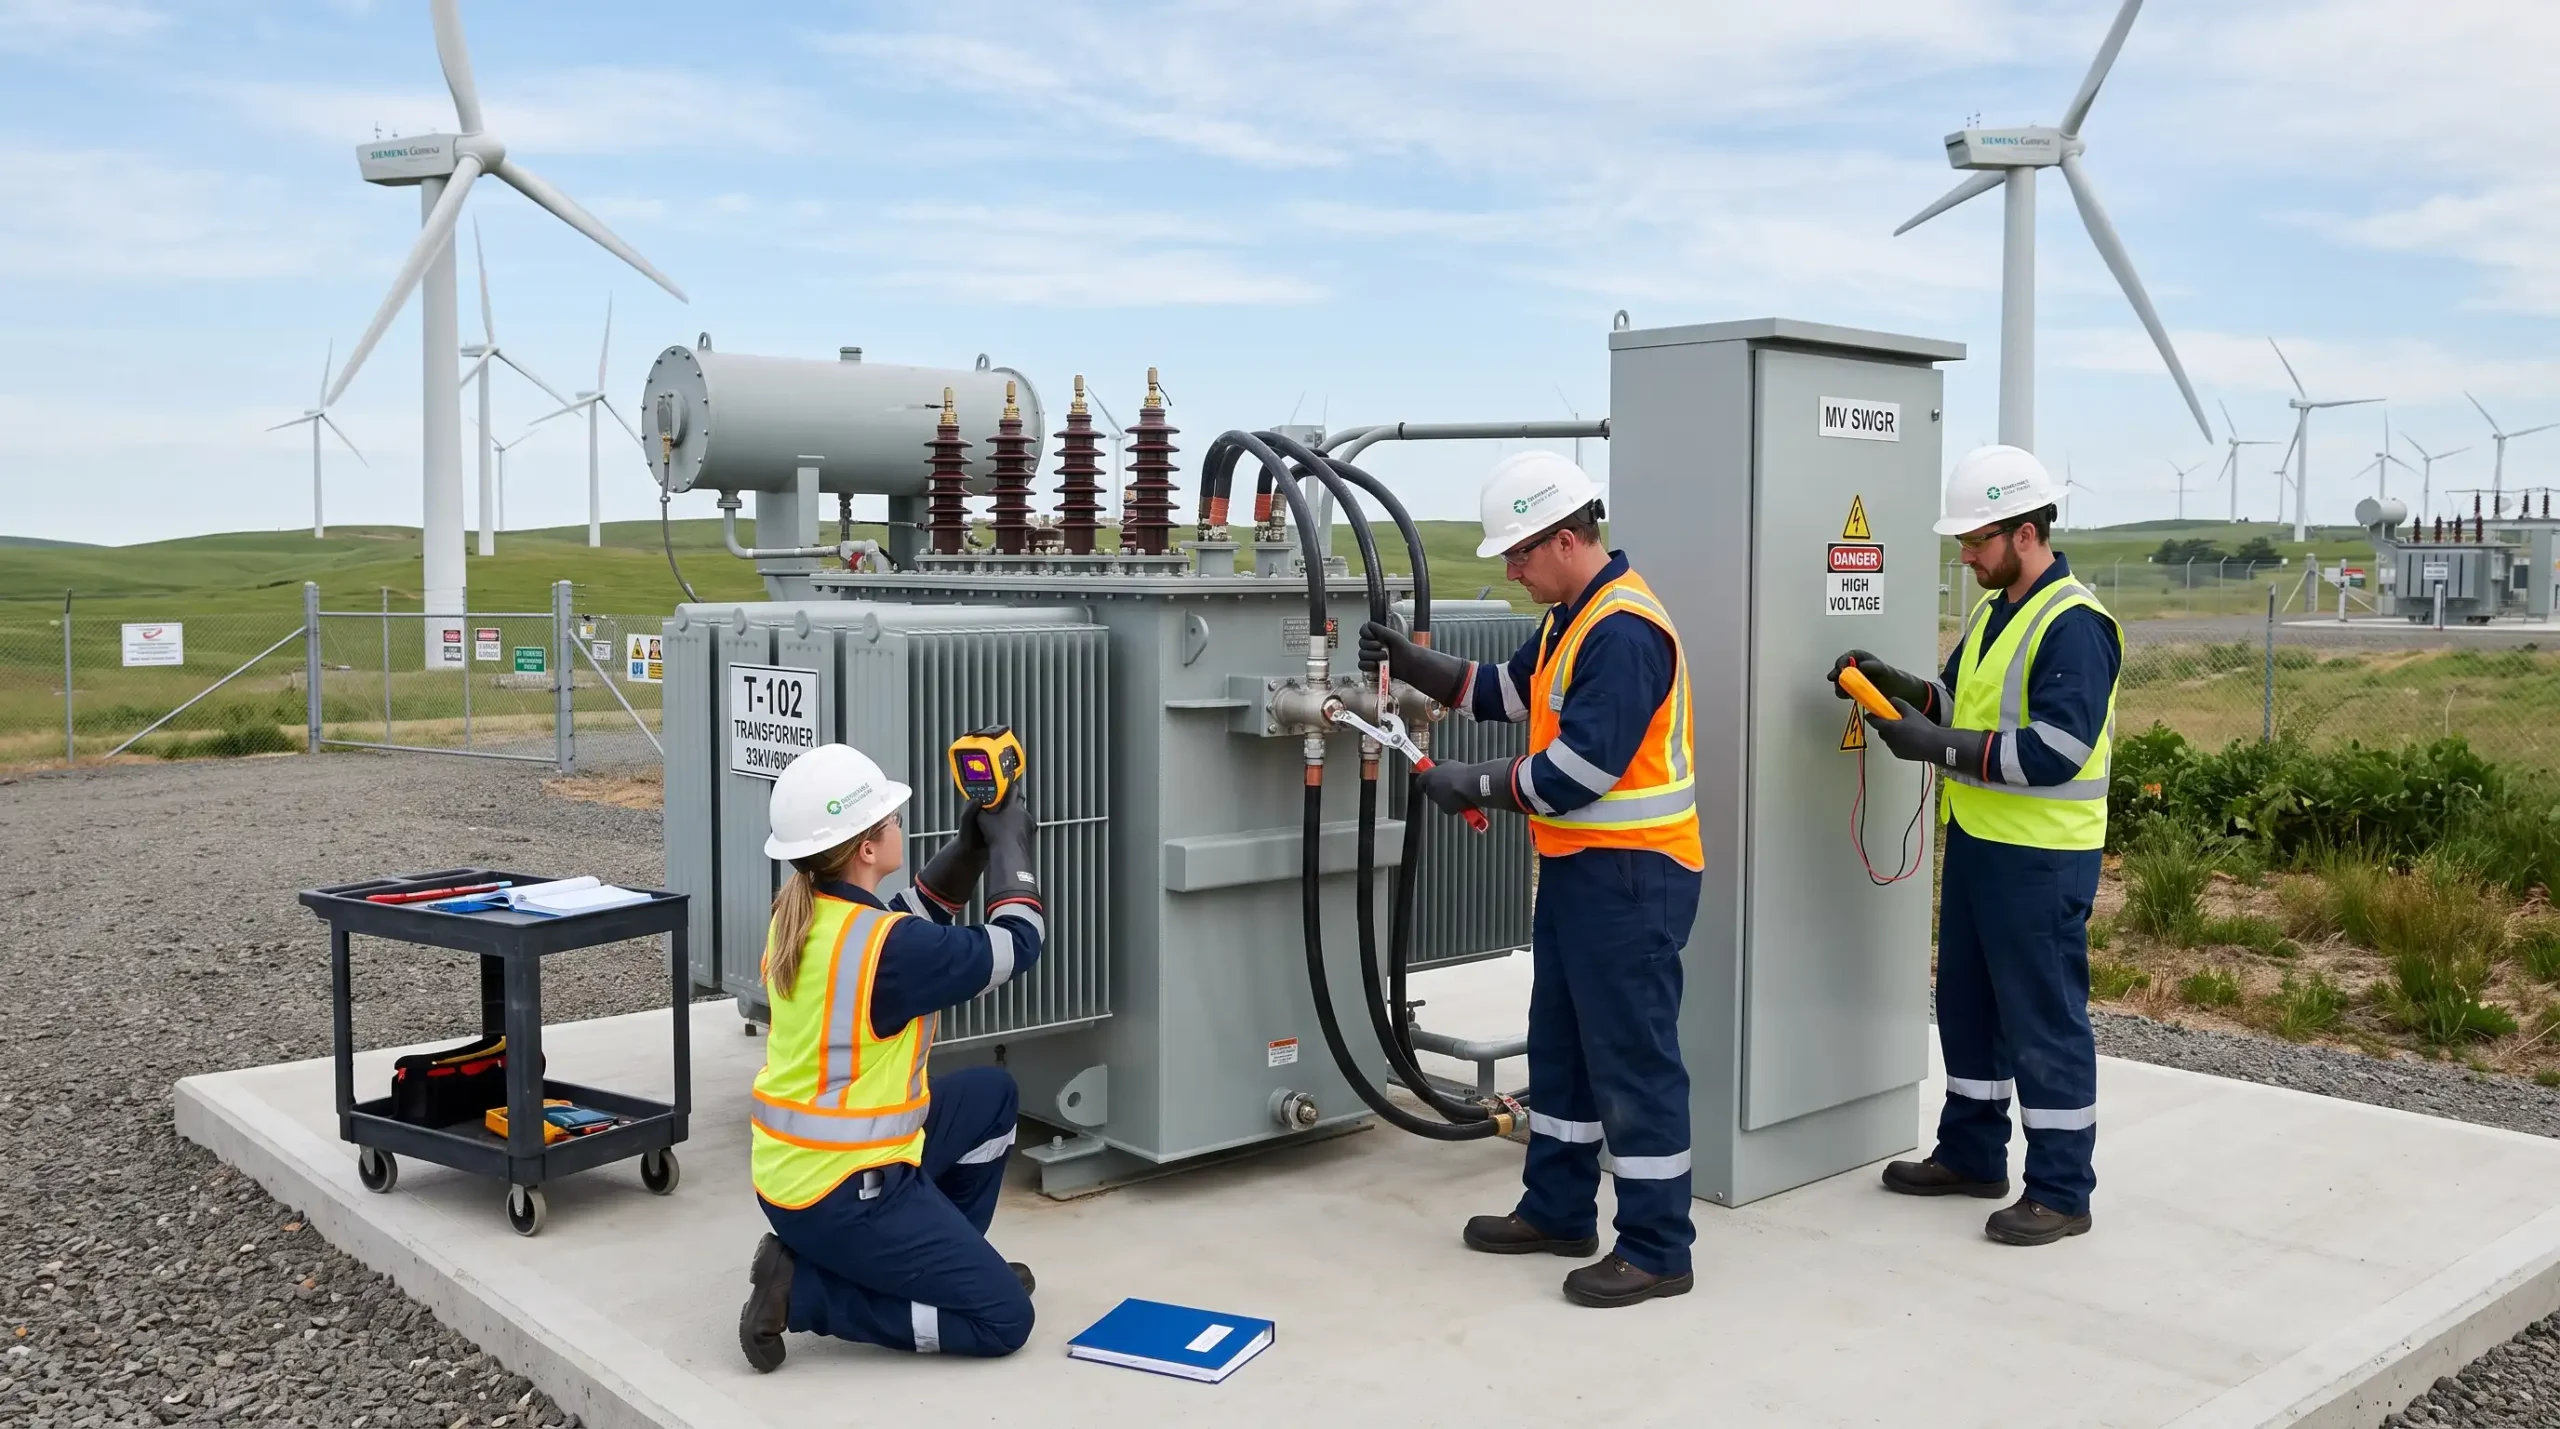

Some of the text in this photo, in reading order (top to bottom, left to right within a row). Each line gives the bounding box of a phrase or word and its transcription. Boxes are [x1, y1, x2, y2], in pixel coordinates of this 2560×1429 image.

[1981, 137, 2019, 146] SIEMENS
[370, 147, 408, 160] SIEMENS
[1825, 405, 1894, 433] MV SWGR
[1833, 552, 1878, 566] DANGER
[1842, 578, 1869, 592] HIGH
[1829, 596, 1880, 611] VOLTAGE
[743, 676, 802, 718] T-102
[734, 719, 814, 747] TRANSFORMER
